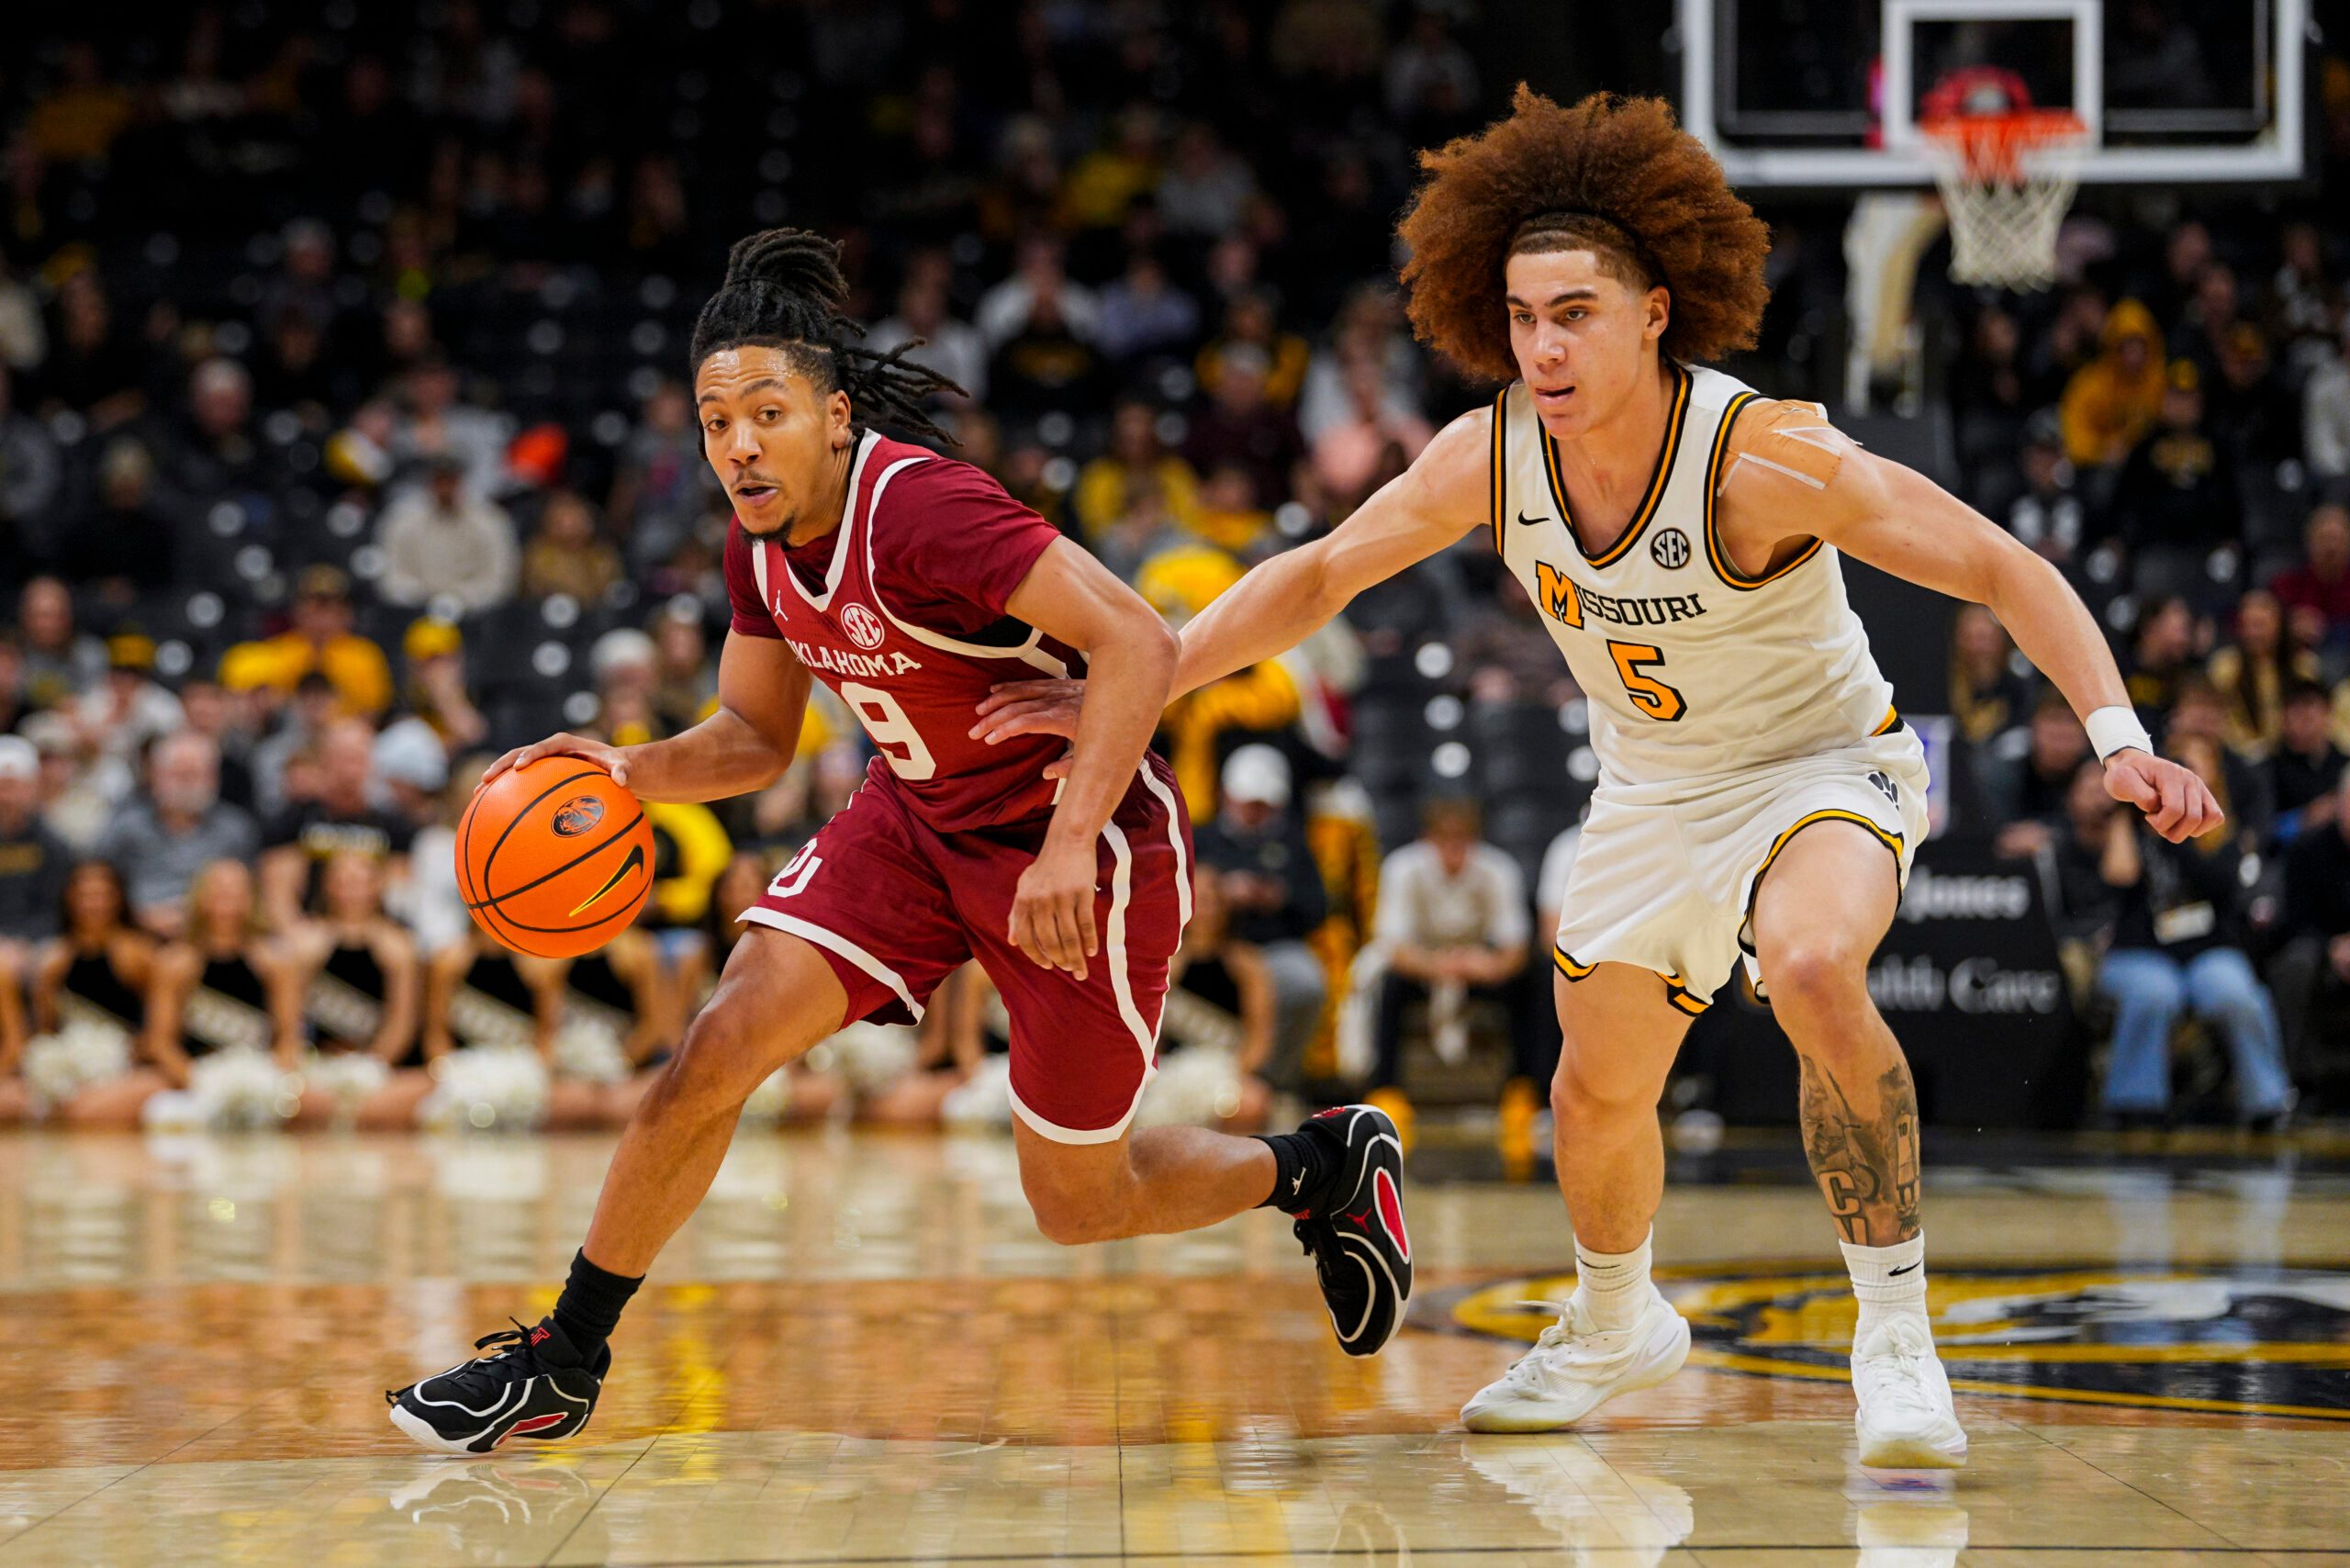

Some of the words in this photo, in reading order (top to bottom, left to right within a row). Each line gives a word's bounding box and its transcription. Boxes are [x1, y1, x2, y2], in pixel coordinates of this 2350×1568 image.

[1652, 531, 1688, 567] SEC
[845, 607, 881, 646] SEC
[1536, 559, 1707, 630] MISSOURI
[1606, 639, 1687, 722] 5
[841, 681, 936, 780] 9
